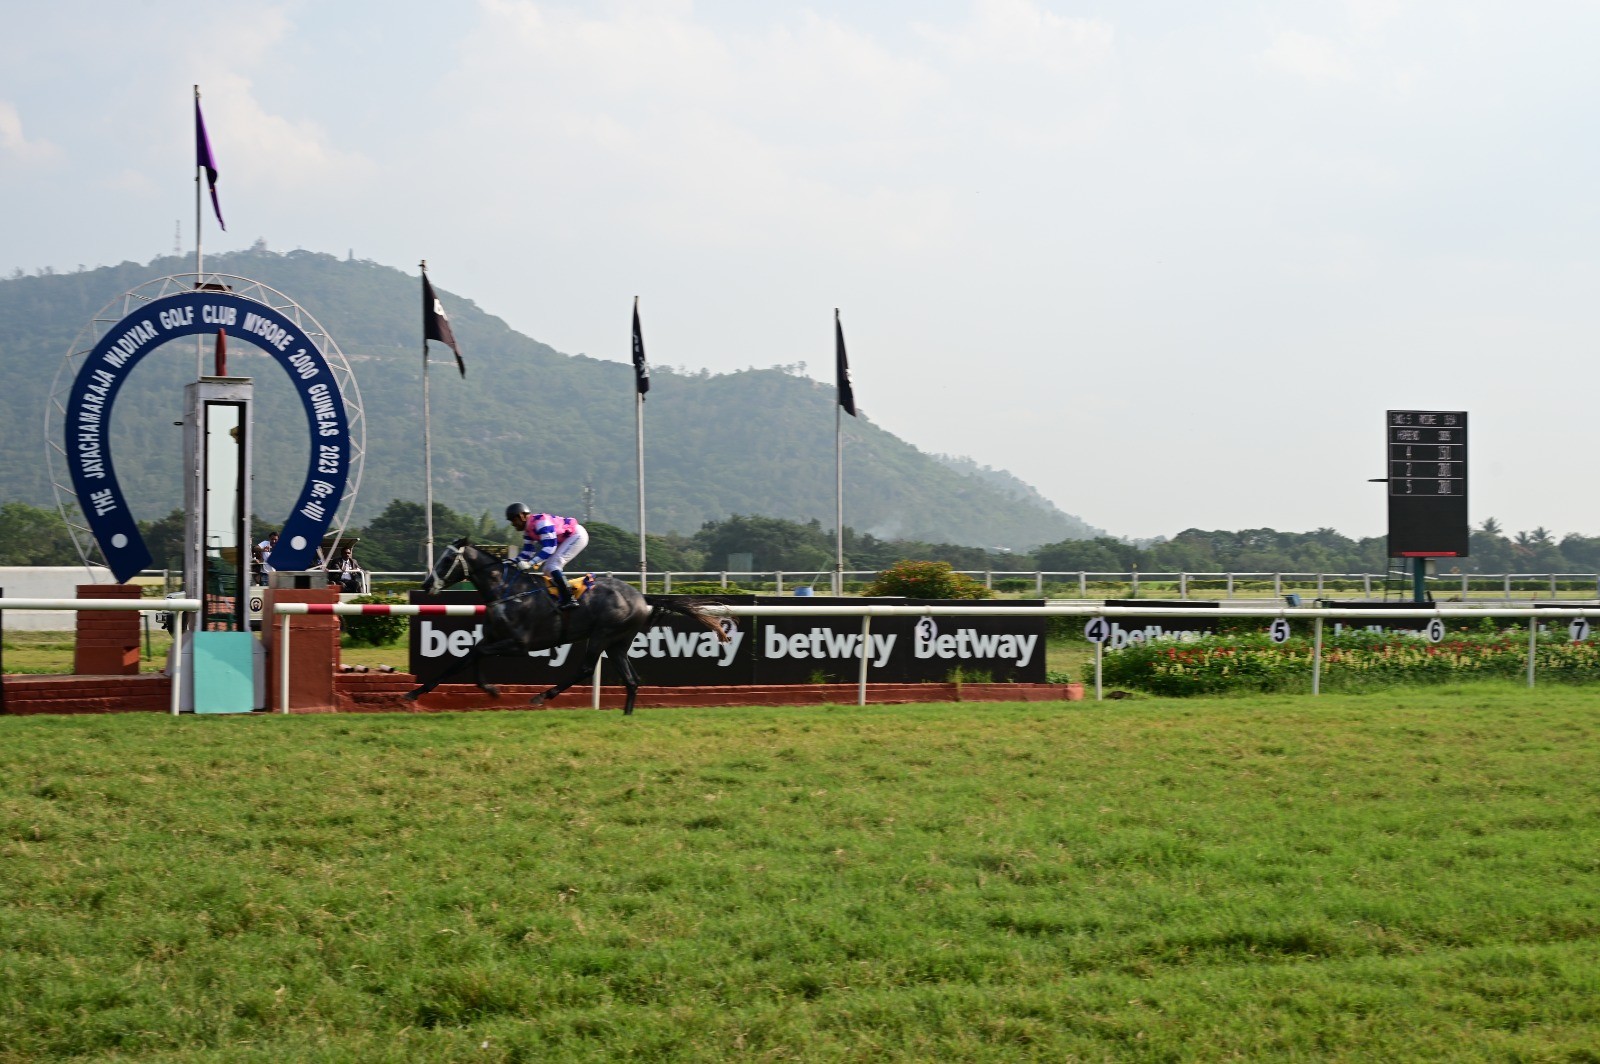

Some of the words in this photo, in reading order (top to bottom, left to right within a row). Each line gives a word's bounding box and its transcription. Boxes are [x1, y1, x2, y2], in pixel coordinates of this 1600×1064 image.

[159, 305, 195, 330] GOLF
[202, 304, 237, 326] CLUB
[103, 319, 159, 369] WADIYAR
[242, 312, 295, 352] MYSORE
[288, 348, 319, 380] 2000
[78, 369, 115, 479] JAYACHAMARAJA
[307, 383, 339, 437] GUINEAS
[317, 445, 340, 474] 2023
[90, 488, 117, 517] THE
[921, 620, 932, 642] 3
[1088, 620, 1103, 642] 4
[1273, 621, 1286, 642] 5
[1430, 621, 1441, 641] 6
[1573, 621, 1585, 640] 7
[601, 625, 745, 667] etway
[764, 625, 897, 668] betway
